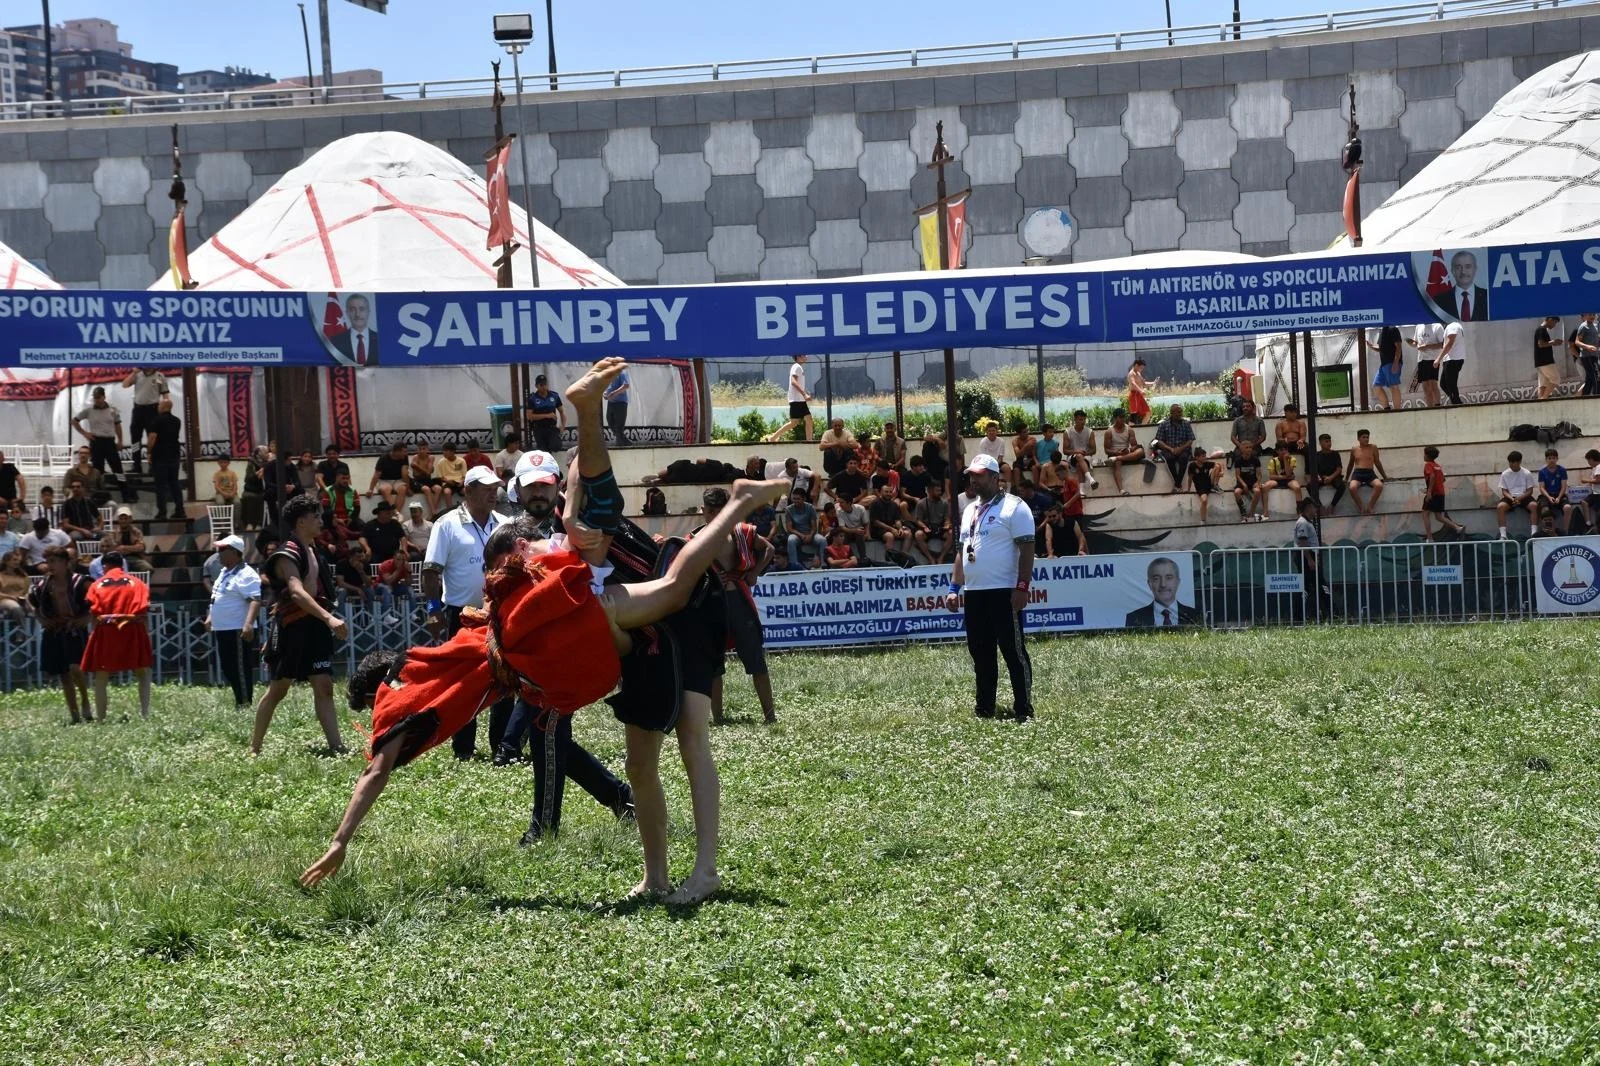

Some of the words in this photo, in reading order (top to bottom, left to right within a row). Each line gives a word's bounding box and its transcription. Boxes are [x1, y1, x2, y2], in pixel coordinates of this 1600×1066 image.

[1111, 277, 1145, 297] TÜM
[1148, 271, 1235, 295] ANTRENÖR
[1240, 275, 1258, 289] ve
[1262, 262, 1408, 288] SPORCULARIMIZA
[1492, 249, 1571, 288] ATA
[1582, 246, 1600, 282] S
[0, 296, 105, 318] SPORUN
[112, 301, 143, 318] ve
[149, 297, 304, 318] SPORCUNUN
[1175, 294, 1270, 316] BAŞARILAR
[1274, 287, 1343, 309] DİLERİM
[77, 322, 232, 343] YANINDAYIZ
[398, 297, 689, 357] ŞAHİNBEY
[755, 281, 1091, 340] BELEDİYESİ
[1136, 326, 1174, 335] Mehmet
[1176, 320, 1243, 332] TAHMAZOĞLU
[1252, 317, 1296, 329] Şahinbey
[1299, 315, 1340, 325] Belediye
[1342, 312, 1380, 322] Başkanı
[25, 352, 66, 361] Mehmet
[68, 350, 140, 360] TAHMAZOĞLU
[150, 351, 194, 361] Şahinbey
[197, 351, 239, 360] Belediye
[241, 350, 279, 360] Başkanı
[752, 583, 775, 598] ALI
[778, 581, 808, 597] ABA
[811, 576, 864, 595] GÜREŞİ
[866, 573, 927, 591] TÜRKİYE
[1052, 563, 1115, 580] KATILAN
[766, 597, 903, 618] PEHLİVANLARIMIZA
[763, 627, 798, 638] hmet
[801, 621, 892, 637] TAHMAZOĞLU
[905, 618, 964, 632] Şahinbey
[1026, 611, 1077, 624] Başkanı
